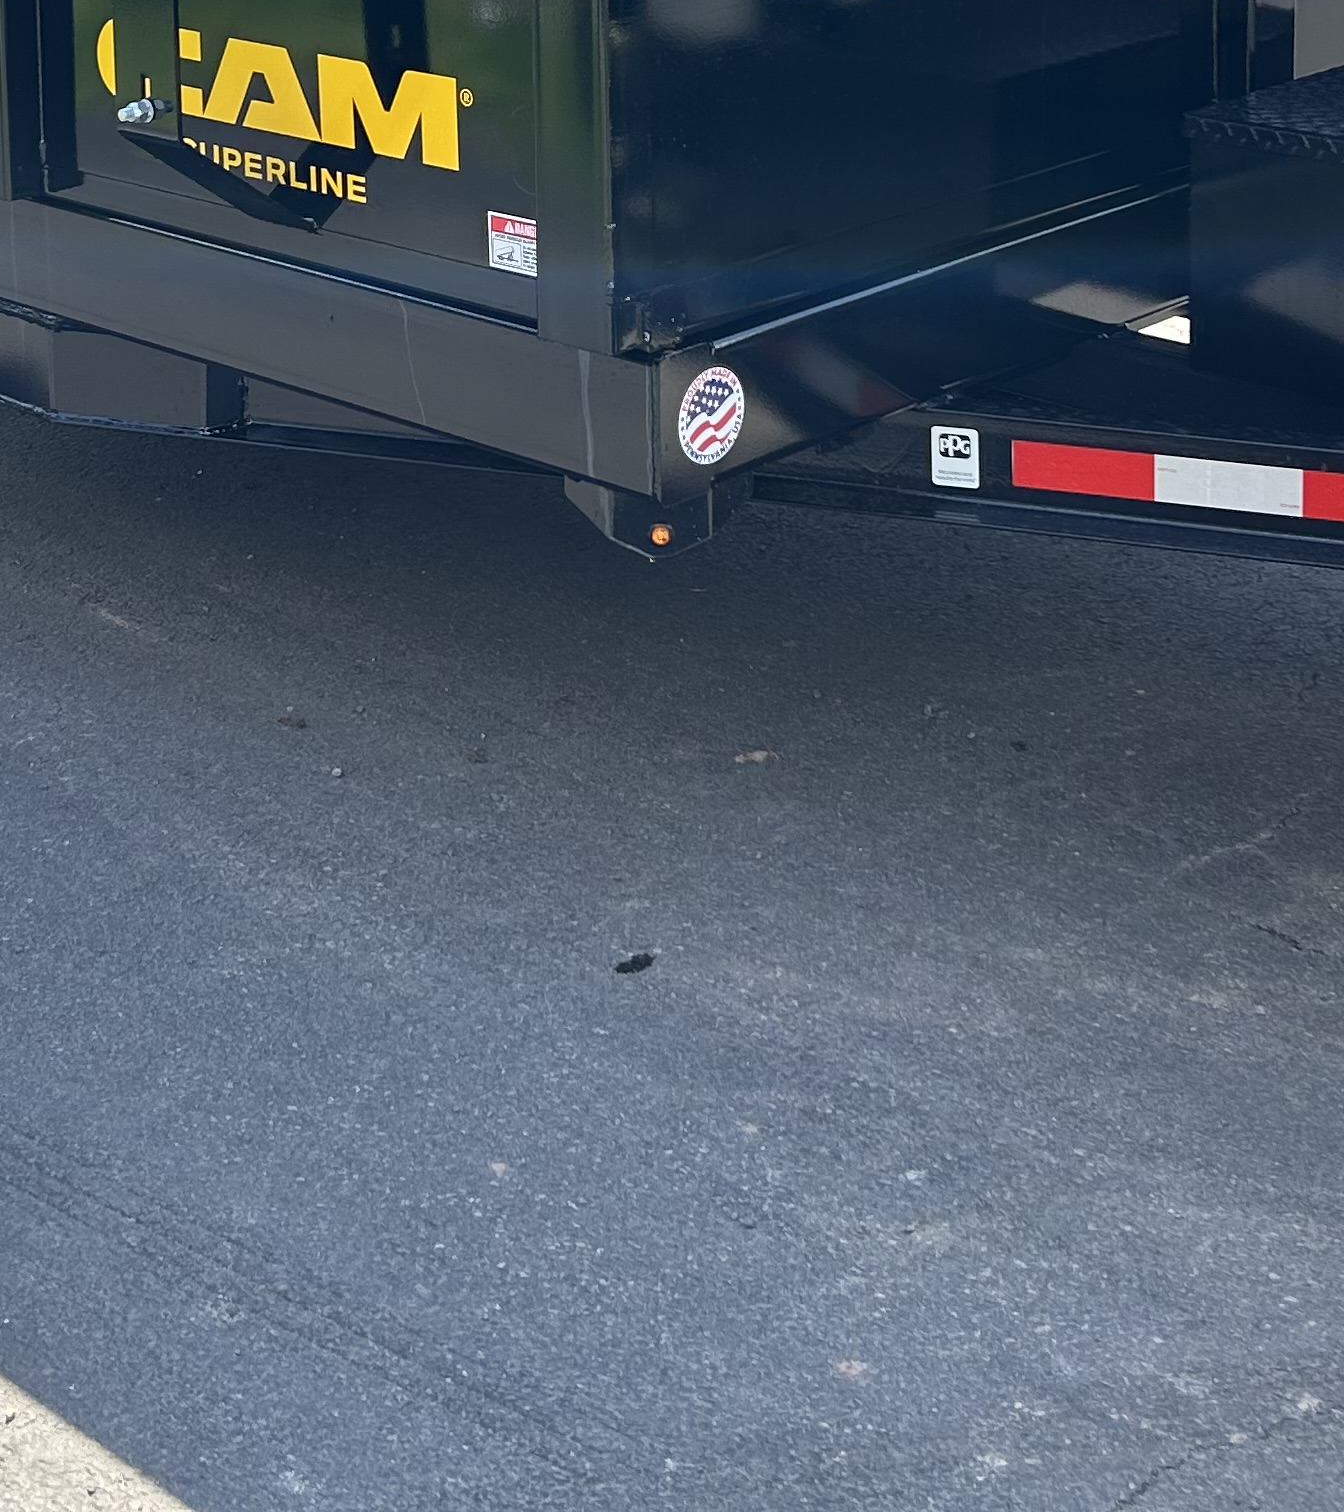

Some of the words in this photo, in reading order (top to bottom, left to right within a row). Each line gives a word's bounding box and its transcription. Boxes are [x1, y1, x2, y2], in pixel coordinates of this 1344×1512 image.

[711, 369, 731, 379] MADE
[731, 413, 742, 434] USA
[939, 435, 971, 456] PPG
